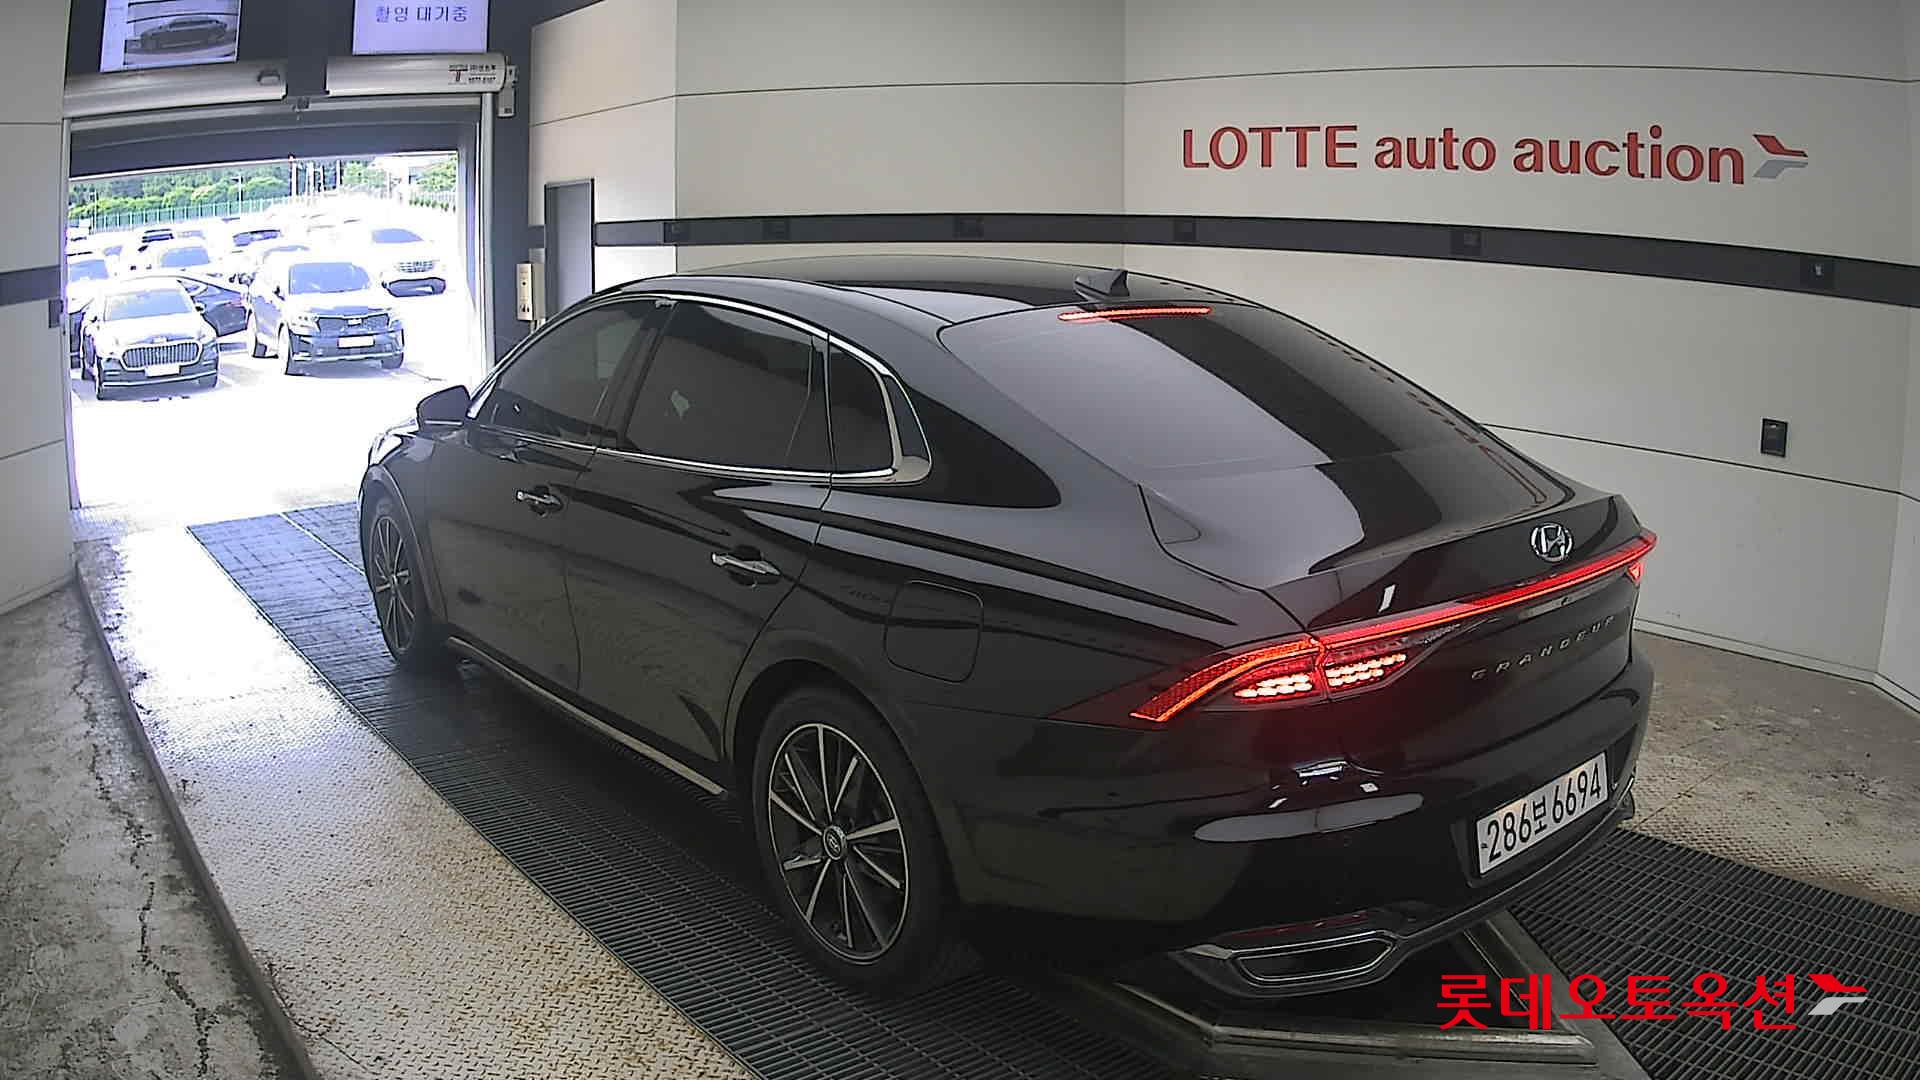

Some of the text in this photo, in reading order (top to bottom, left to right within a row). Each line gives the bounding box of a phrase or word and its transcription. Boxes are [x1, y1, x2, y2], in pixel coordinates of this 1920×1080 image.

[416, 6, 467, 22] 대기중
[1183, 125, 1744, 184] LOTTE auto auction
[1471, 615, 1614, 680] GRANDEUR
